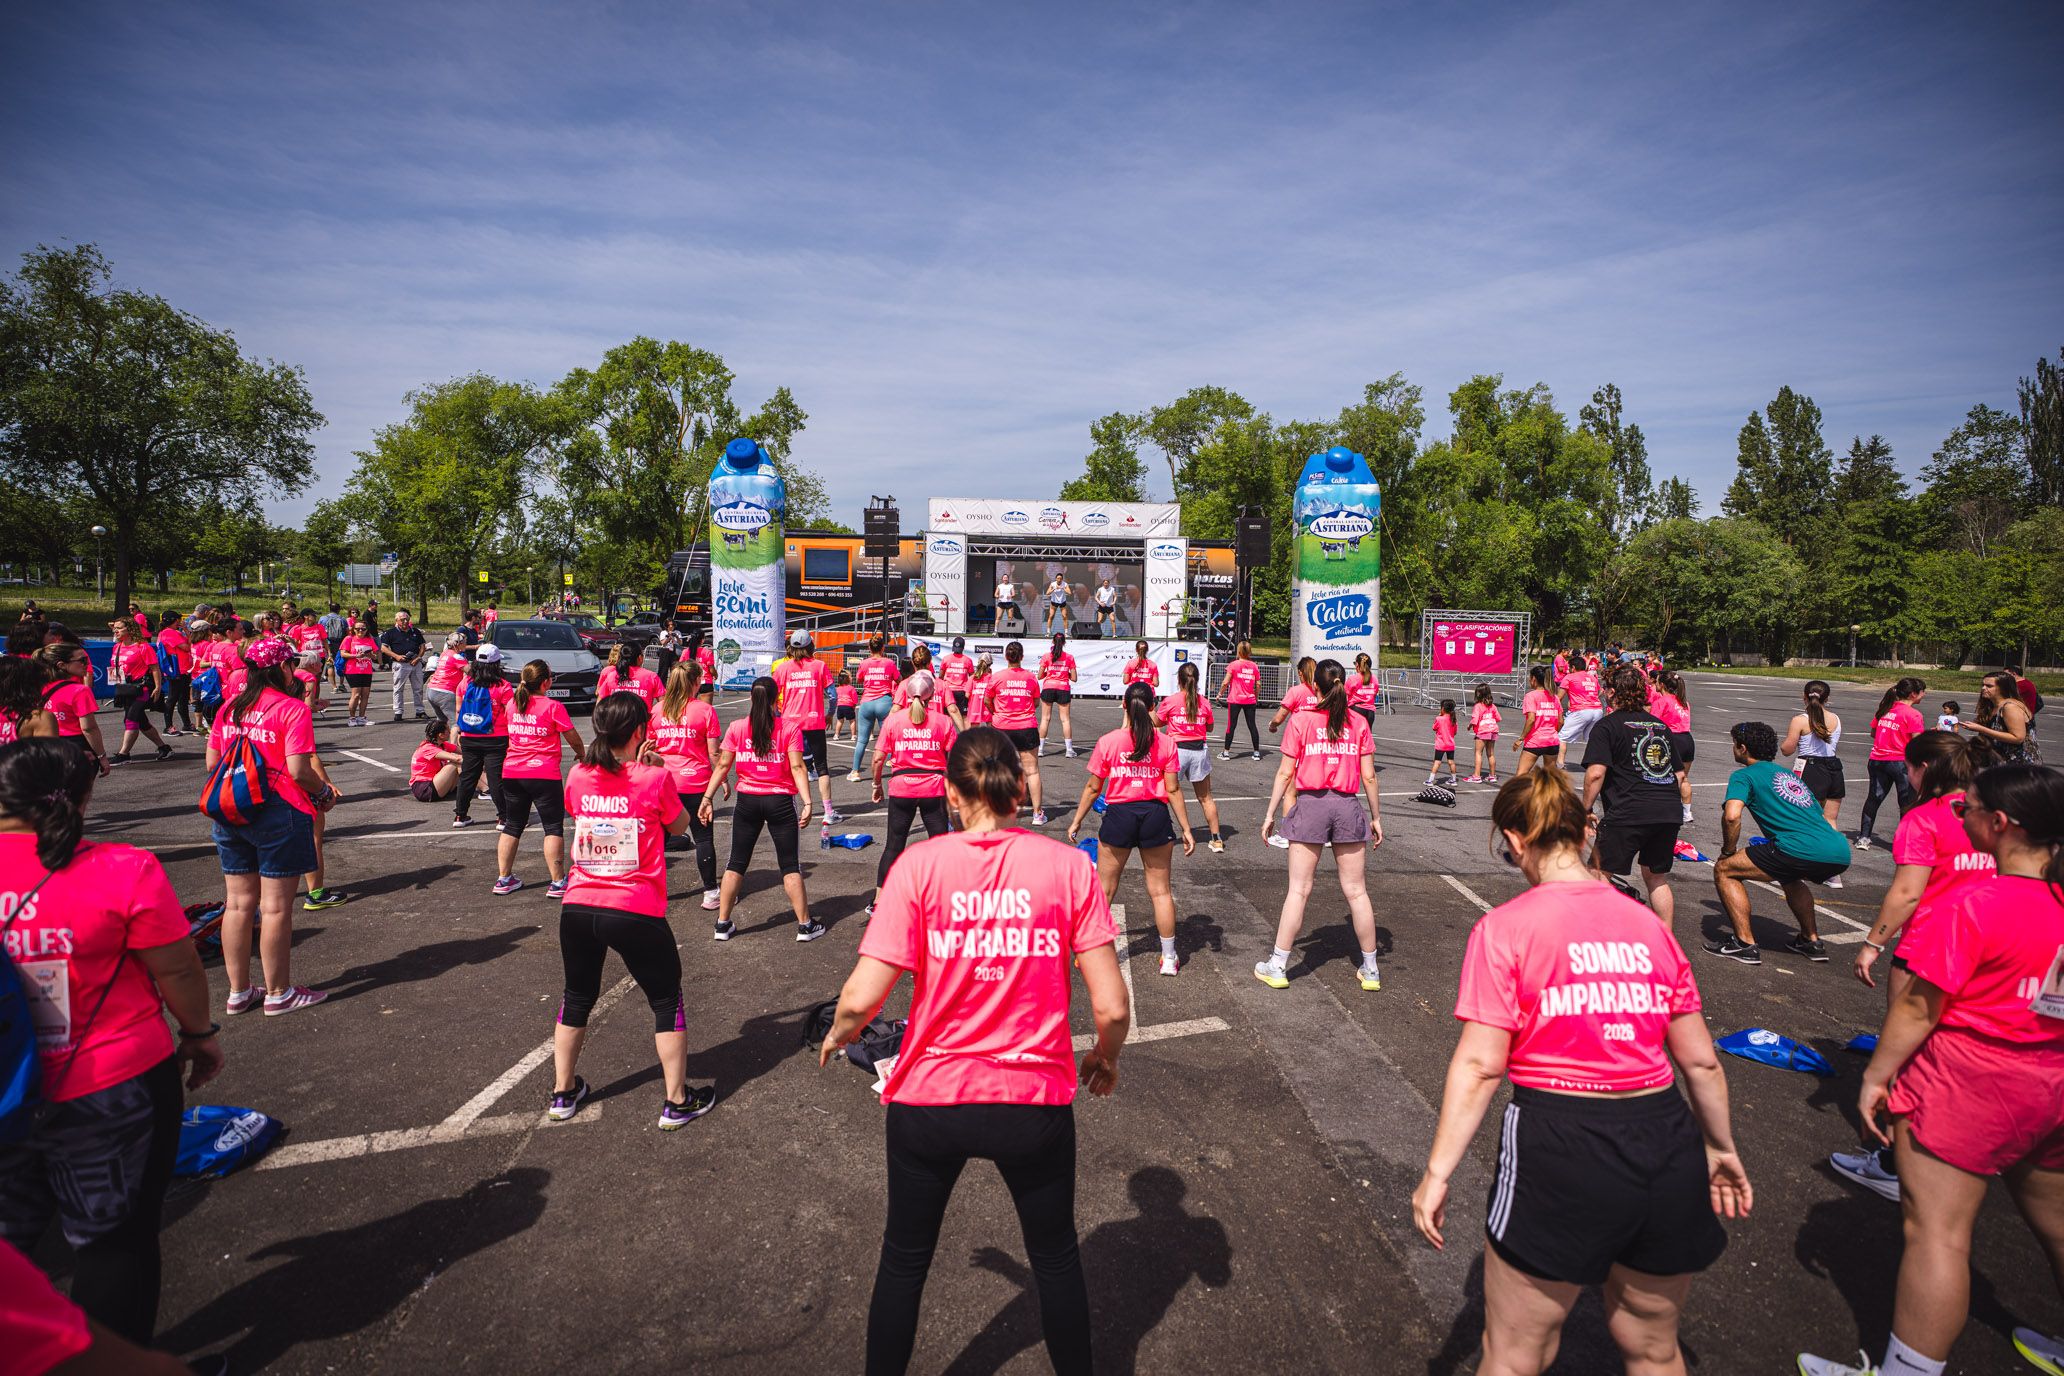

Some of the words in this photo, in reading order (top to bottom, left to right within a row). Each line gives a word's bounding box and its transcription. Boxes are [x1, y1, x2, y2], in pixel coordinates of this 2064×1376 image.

[716, 511, 767, 523] ASTURIANA
[1313, 521, 1369, 532] ASTURIANA
[930, 572, 960, 580] OYSHO
[717, 578, 746, 596] Leche
[1311, 590, 1327, 600] Leche
[715, 592, 772, 614] semi
[1312, 600, 1364, 625] Calcio
[716, 613, 773, 629] desnatada
[1334, 624, 1363, 636] natural
[790, 670, 812, 679] SOMOS
[1006, 680, 1027, 688] SOMOS
[512, 712, 537, 724] SOMOS
[903, 728, 932, 739] SOMOS
[894, 740, 941, 752] IMPARABLES
[1305, 742, 1358, 756] IMPARABLES
[581, 794, 629, 814] SOMOS
[594, 845, 617, 855] 016
[951, 888, 1031, 922] SOMOS
[927, 927, 1060, 959] IMPARABLES
[1567, 941, 1653, 975] SOMOS
[974, 965, 1005, 982] 2026
[1603, 1023, 1636, 1041] 2026
